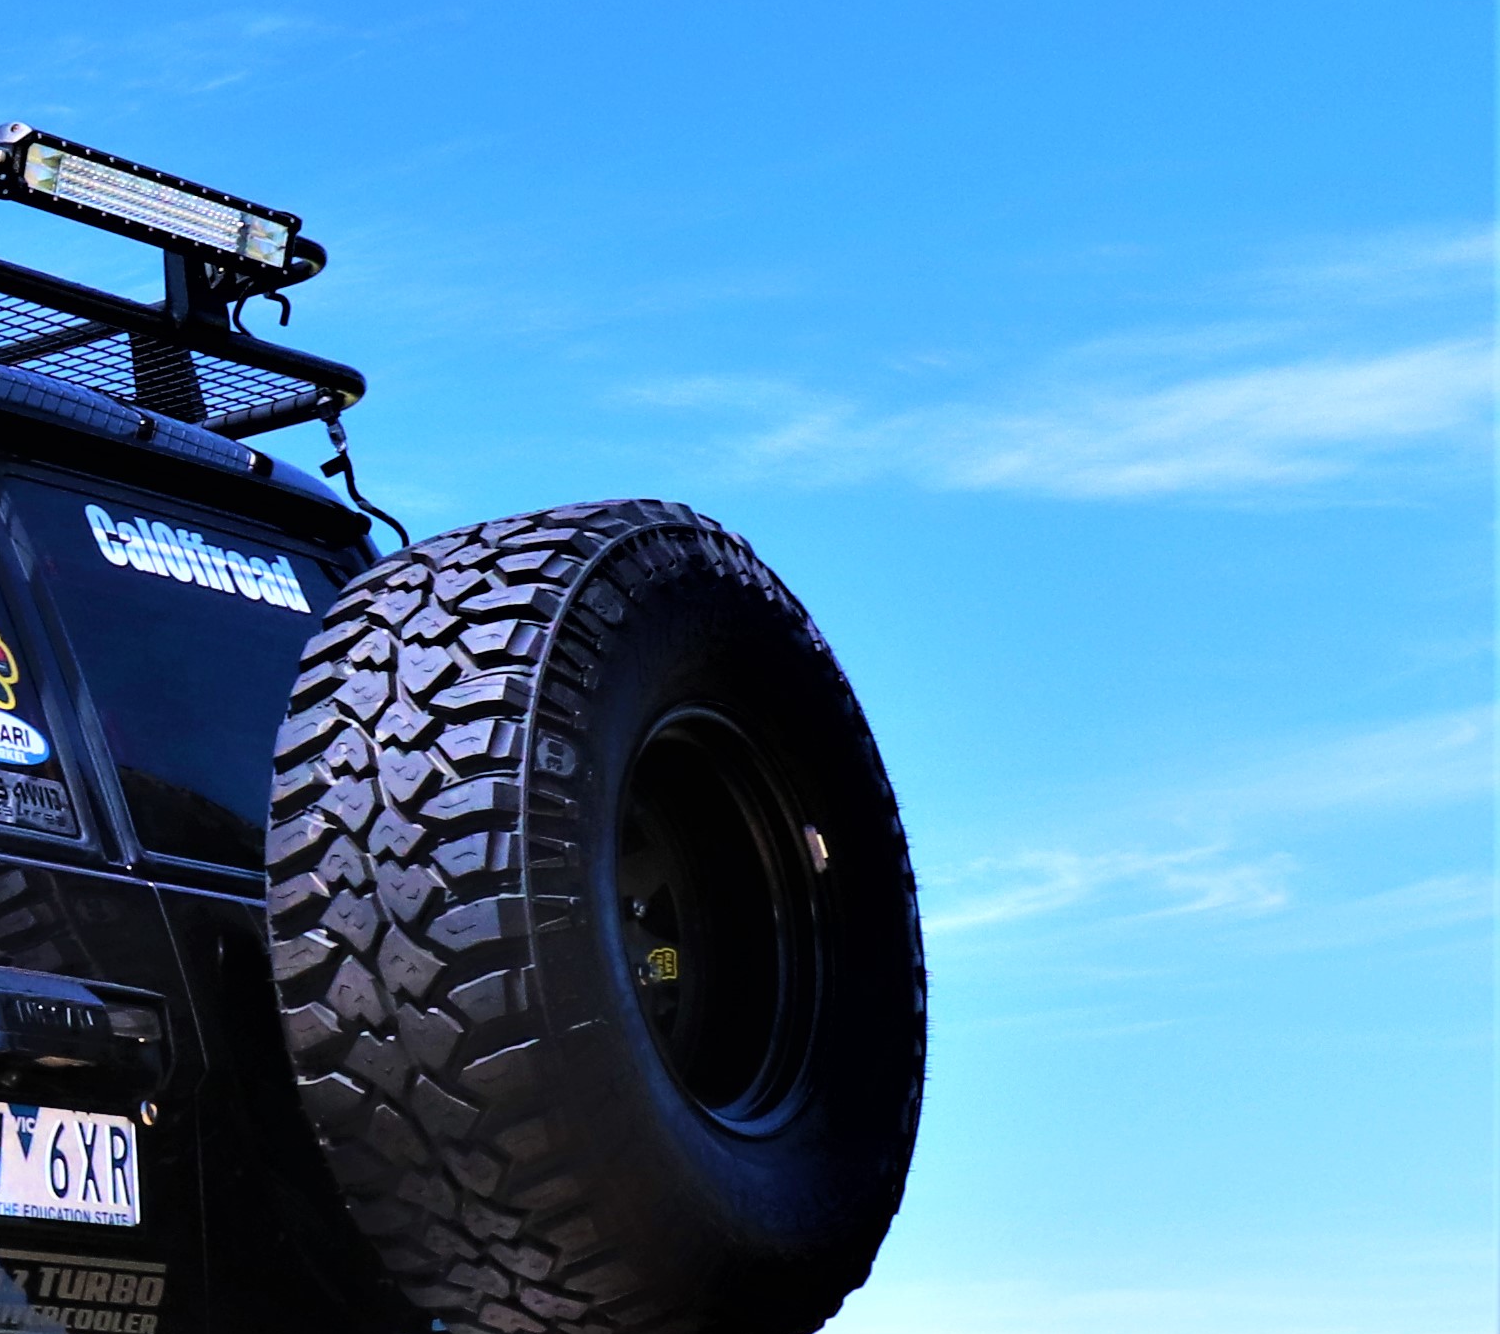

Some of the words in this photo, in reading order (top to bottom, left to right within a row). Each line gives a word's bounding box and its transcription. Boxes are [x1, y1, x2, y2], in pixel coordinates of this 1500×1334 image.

[14, 1116, 36, 1134] VIC
[46, 1119, 132, 1208] 6XR
[23, 1204, 92, 1224] EDUCATION
[94, 1210, 129, 1226] STATE
[38, 1266, 165, 1307] TURBO
